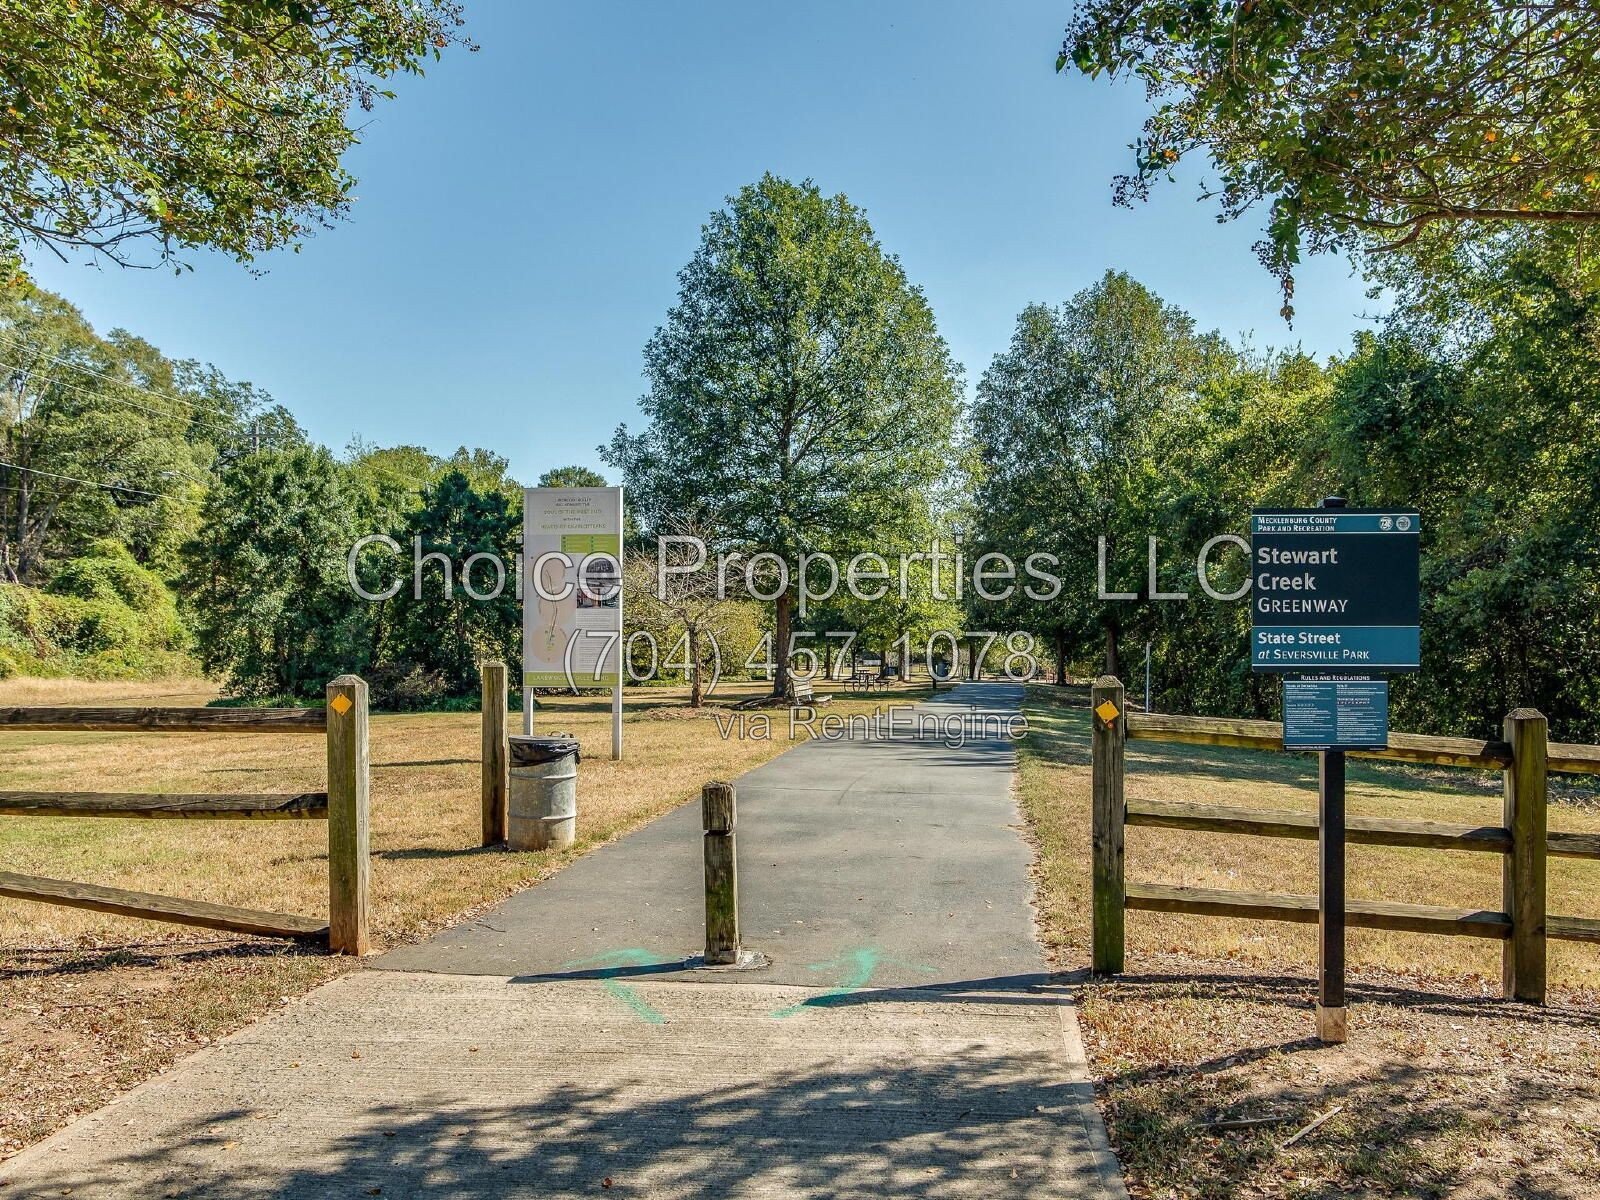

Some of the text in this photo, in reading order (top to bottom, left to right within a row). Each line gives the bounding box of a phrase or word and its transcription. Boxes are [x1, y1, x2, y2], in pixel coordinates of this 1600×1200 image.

[1257, 516, 1338, 524] MECKLENBURG COUNTY
[1257, 524, 1276, 532] PARK
[1293, 524, 1335, 532] RECREATION
[1257, 547, 1339, 565] Stewart
[1257, 572, 1317, 591] Creek
[1257, 596, 1349, 613] GREENWAY
[1257, 631, 1341, 645] State Street
[1257, 649, 1371, 660] at SEVERSVILLE PARK
